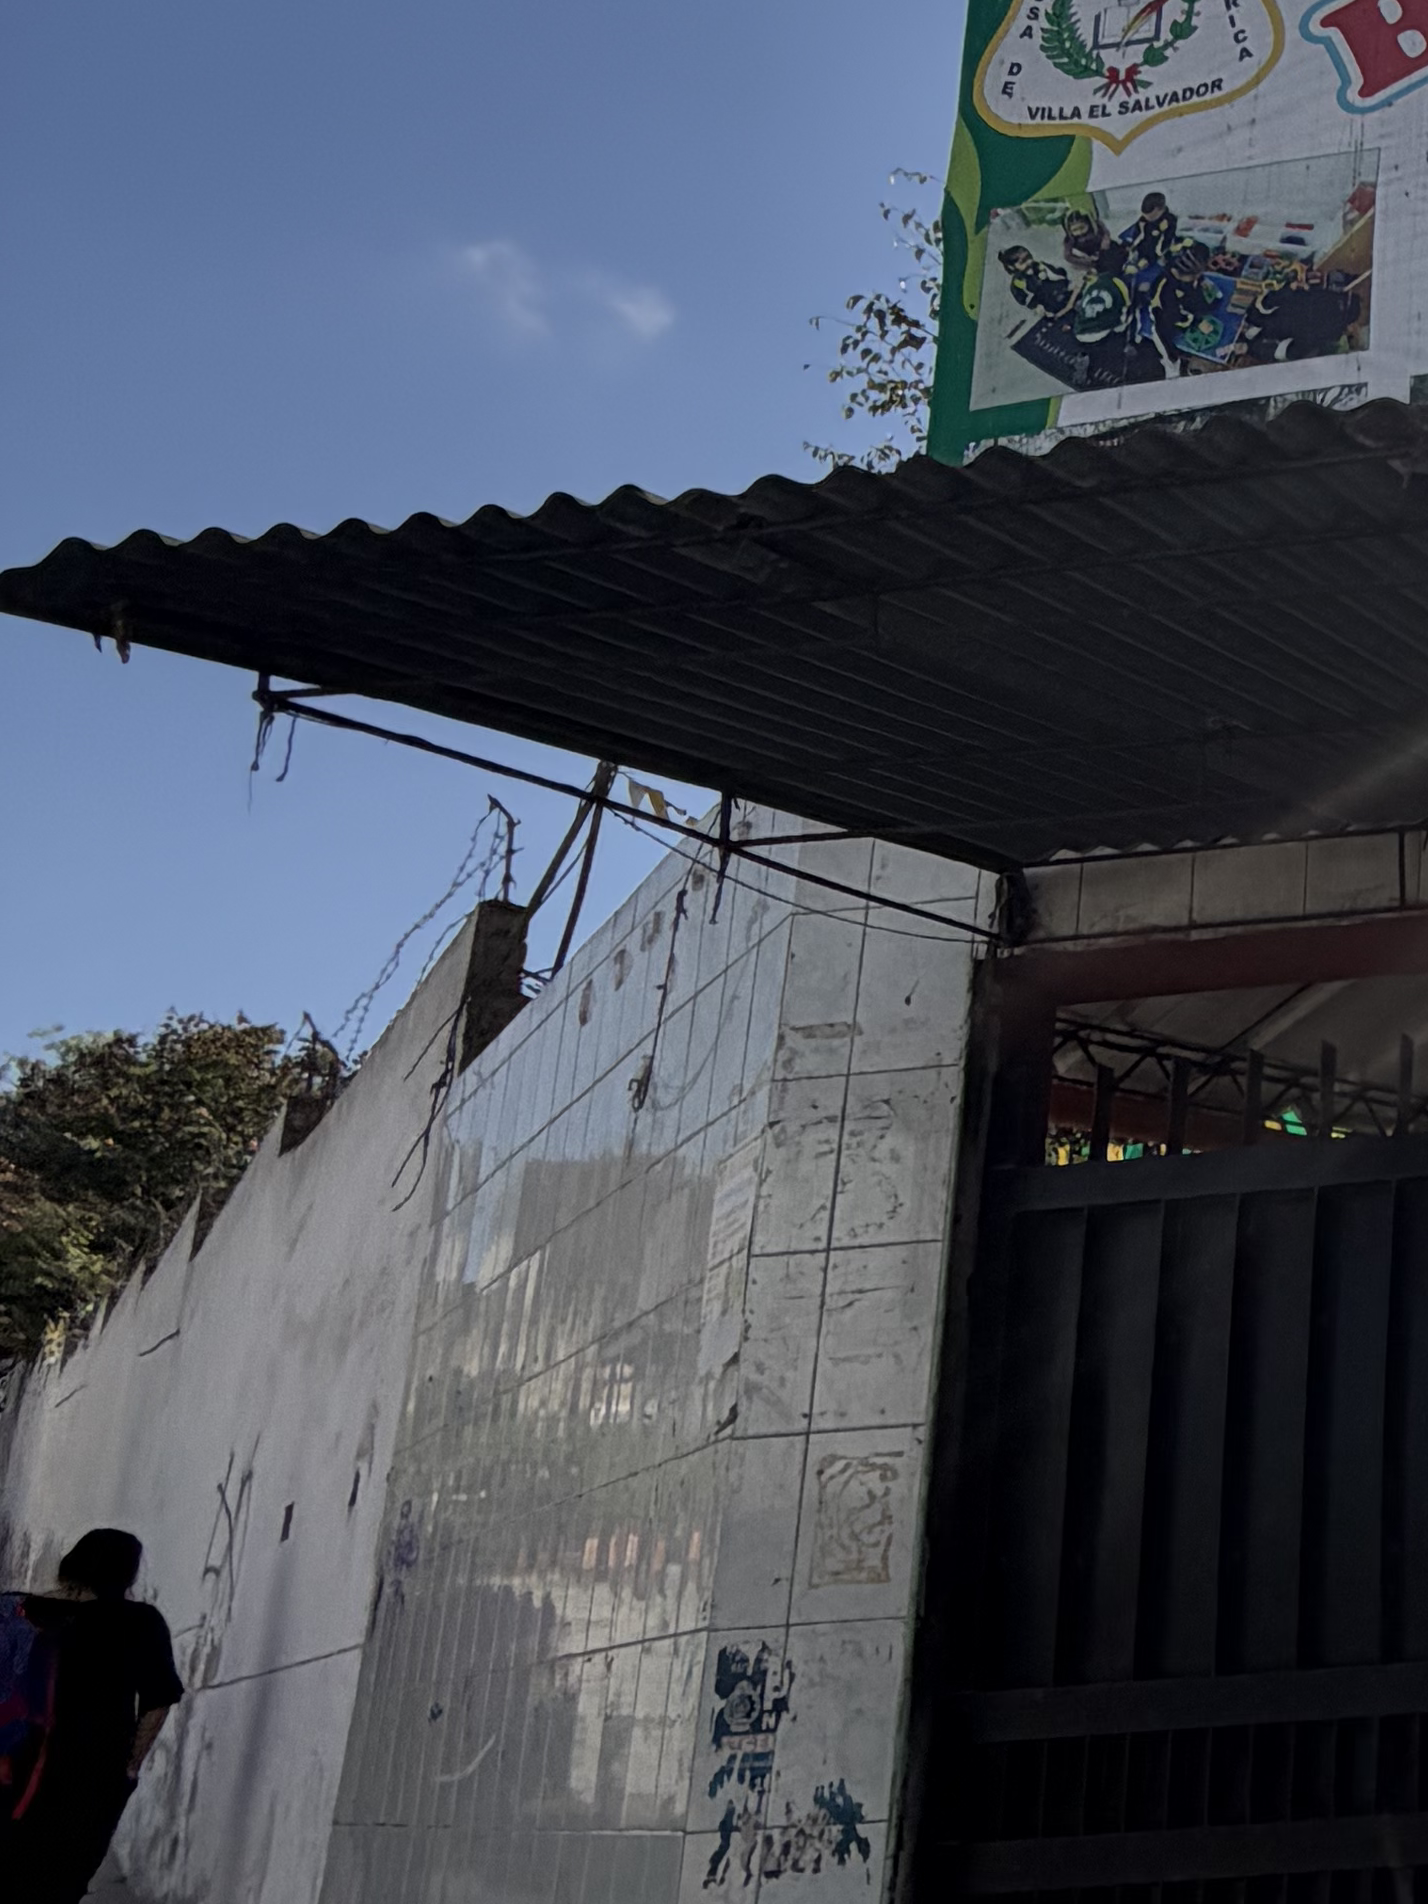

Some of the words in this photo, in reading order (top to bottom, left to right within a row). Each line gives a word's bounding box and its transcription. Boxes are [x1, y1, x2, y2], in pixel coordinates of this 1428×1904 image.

[1001, 62, 1022, 98] DE
[1027, 106, 1082, 121] VILLA
[1088, 103, 1111, 119] EL
[1118, 78, 1223, 115] SALVADOR
